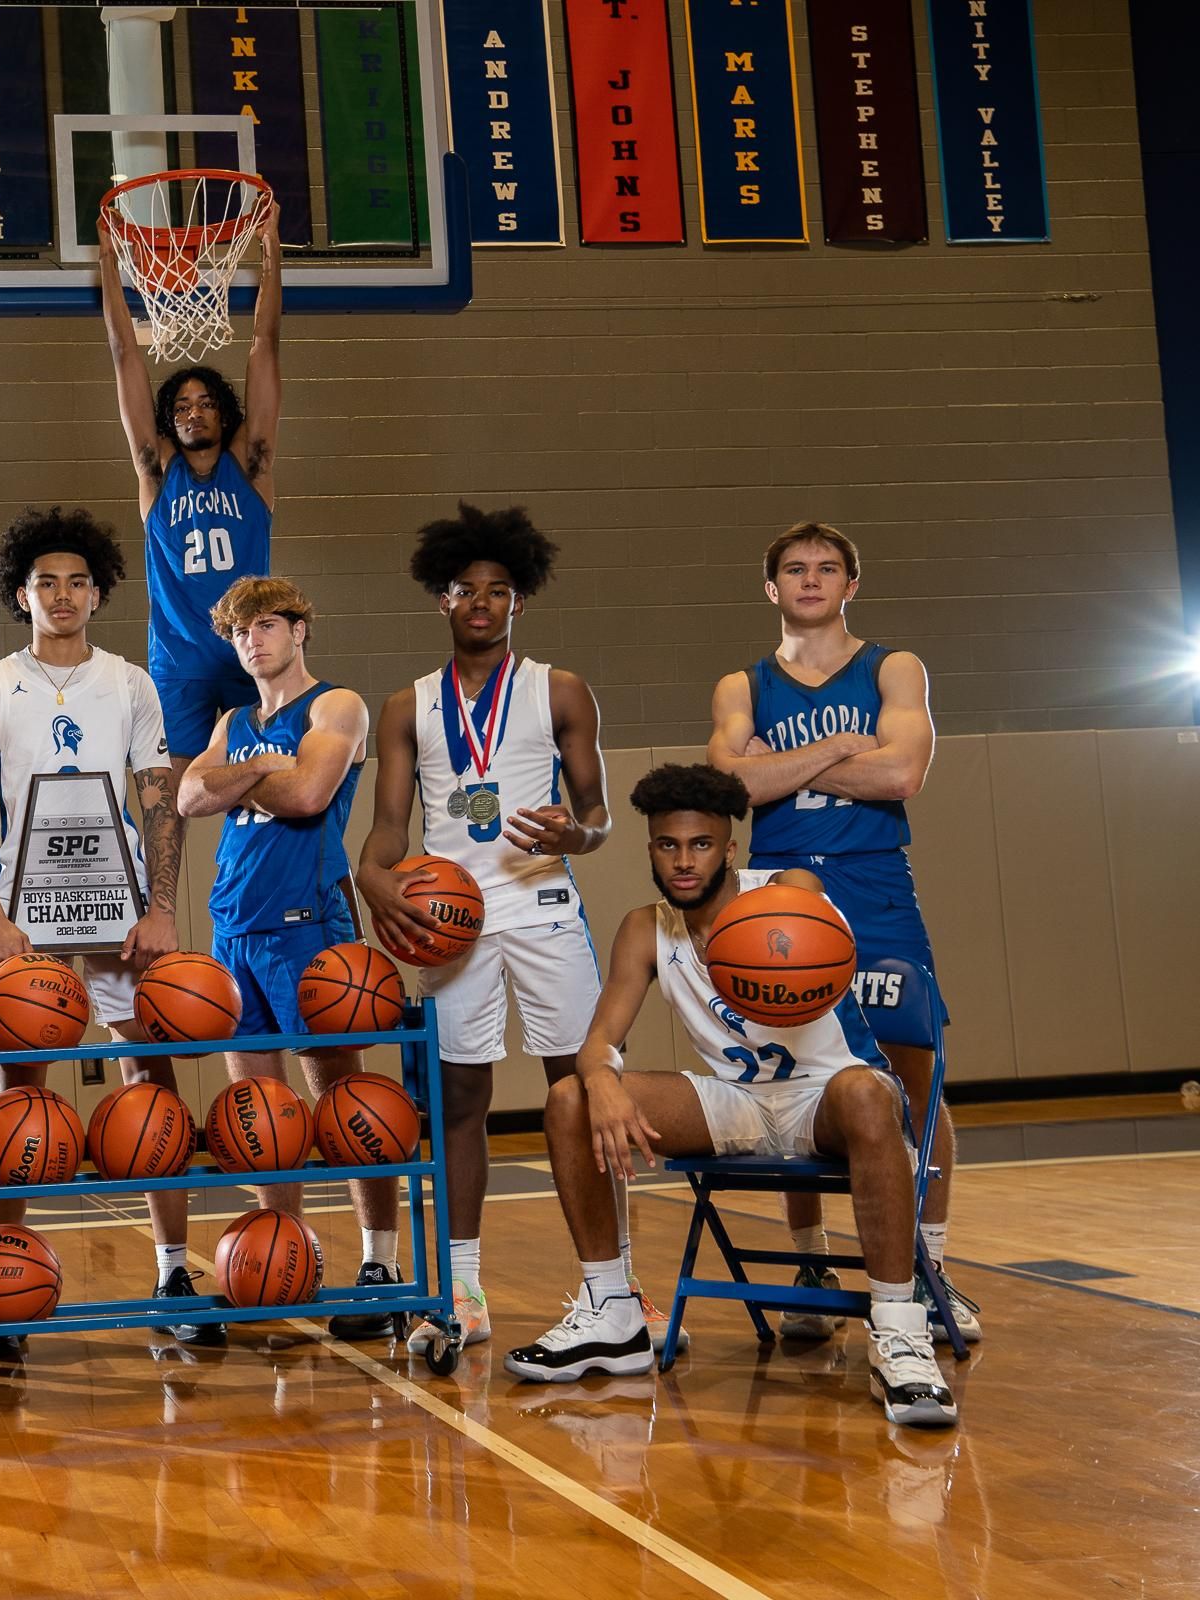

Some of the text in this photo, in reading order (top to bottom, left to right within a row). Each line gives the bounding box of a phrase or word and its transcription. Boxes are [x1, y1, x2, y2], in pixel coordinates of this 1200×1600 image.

[483, 30, 518, 231] ANDREWS
[607, 69, 641, 232] JOHNS
[725, 52, 761, 205] MARKS
[851, 25, 884, 231] STEPHENS
[977, 107, 1005, 232] VALLEY
[184, 527, 235, 575] 20
[46, 835, 100, 857] SPC
[23, 889, 128, 904] BOYS BASKETBALL
[27, 903, 125, 923] CHAMPION
[56, 925, 97, 936] 2021-2022
[29, 978, 88, 1009] EVOLUTION
[730, 974, 835, 1006] Wilson
[144, 1107, 176, 1175] EVOLUTION
[233, 1085, 265, 1159] Wilson
